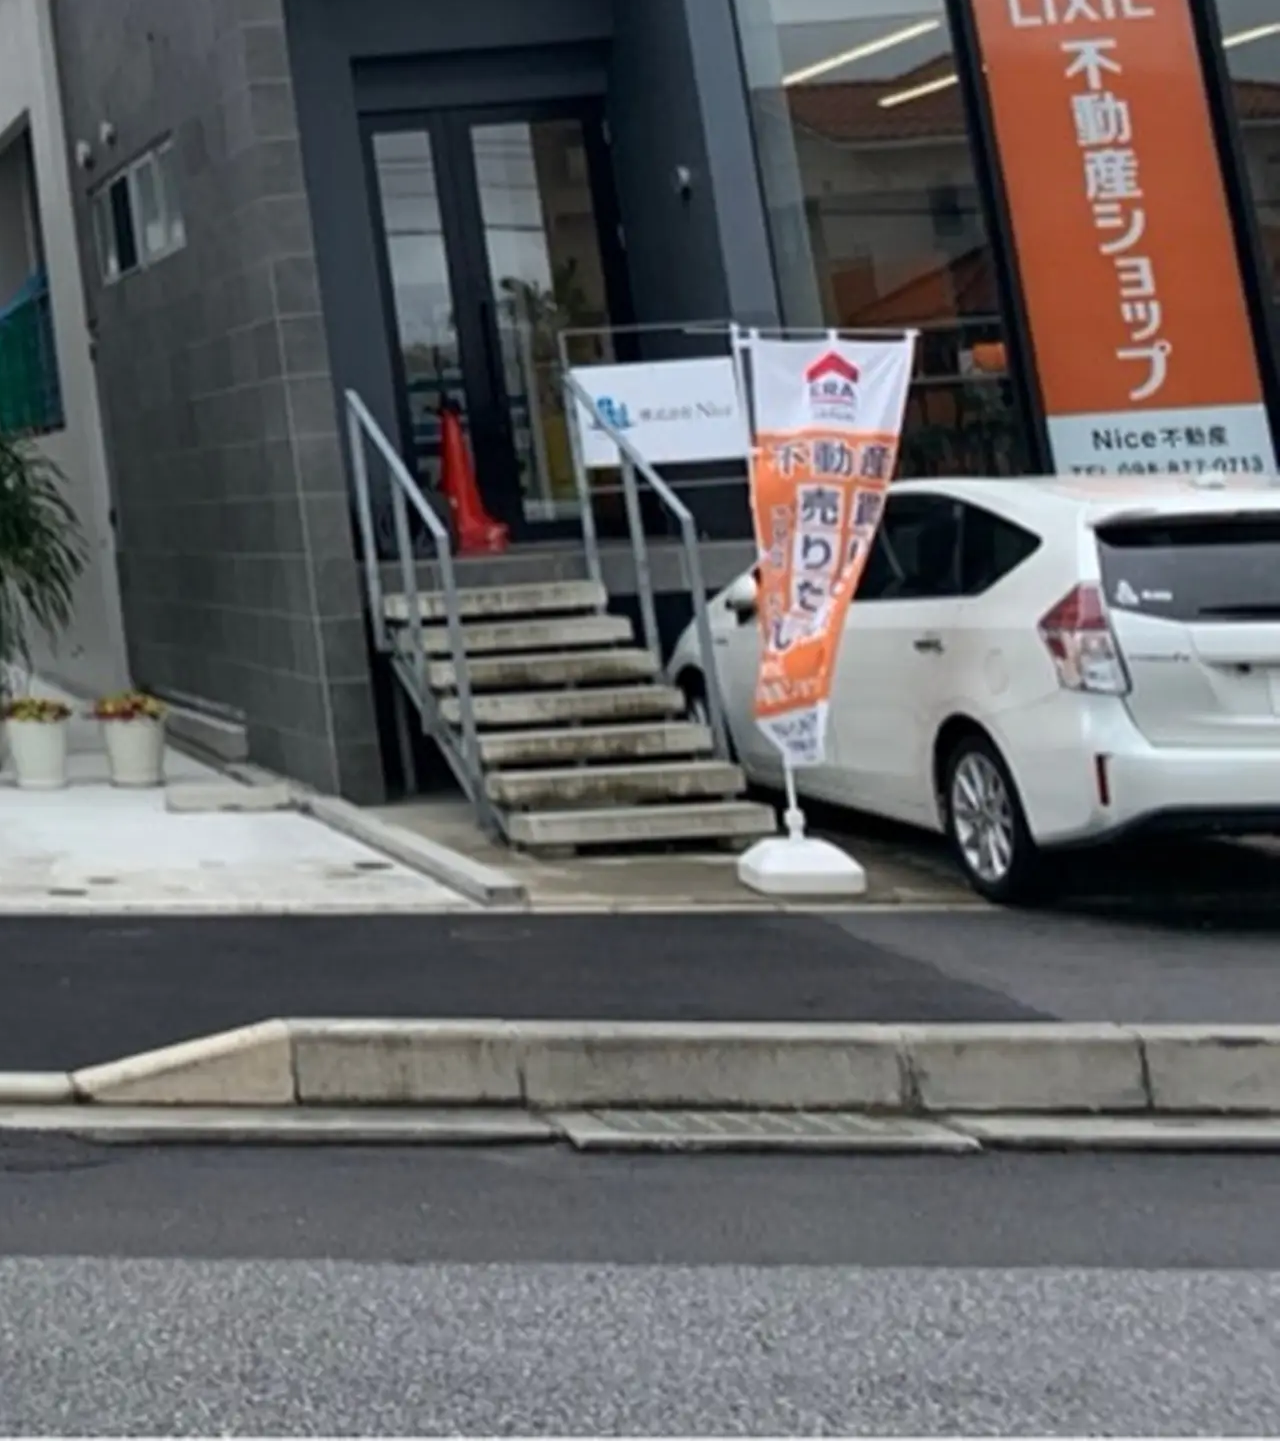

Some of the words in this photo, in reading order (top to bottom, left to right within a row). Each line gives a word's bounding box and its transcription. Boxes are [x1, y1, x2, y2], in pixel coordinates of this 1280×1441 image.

[1060, 38, 1172, 401] 不動産ショップ
[810, 379, 854, 397] ERA
[774, 439, 891, 479] 不動産
